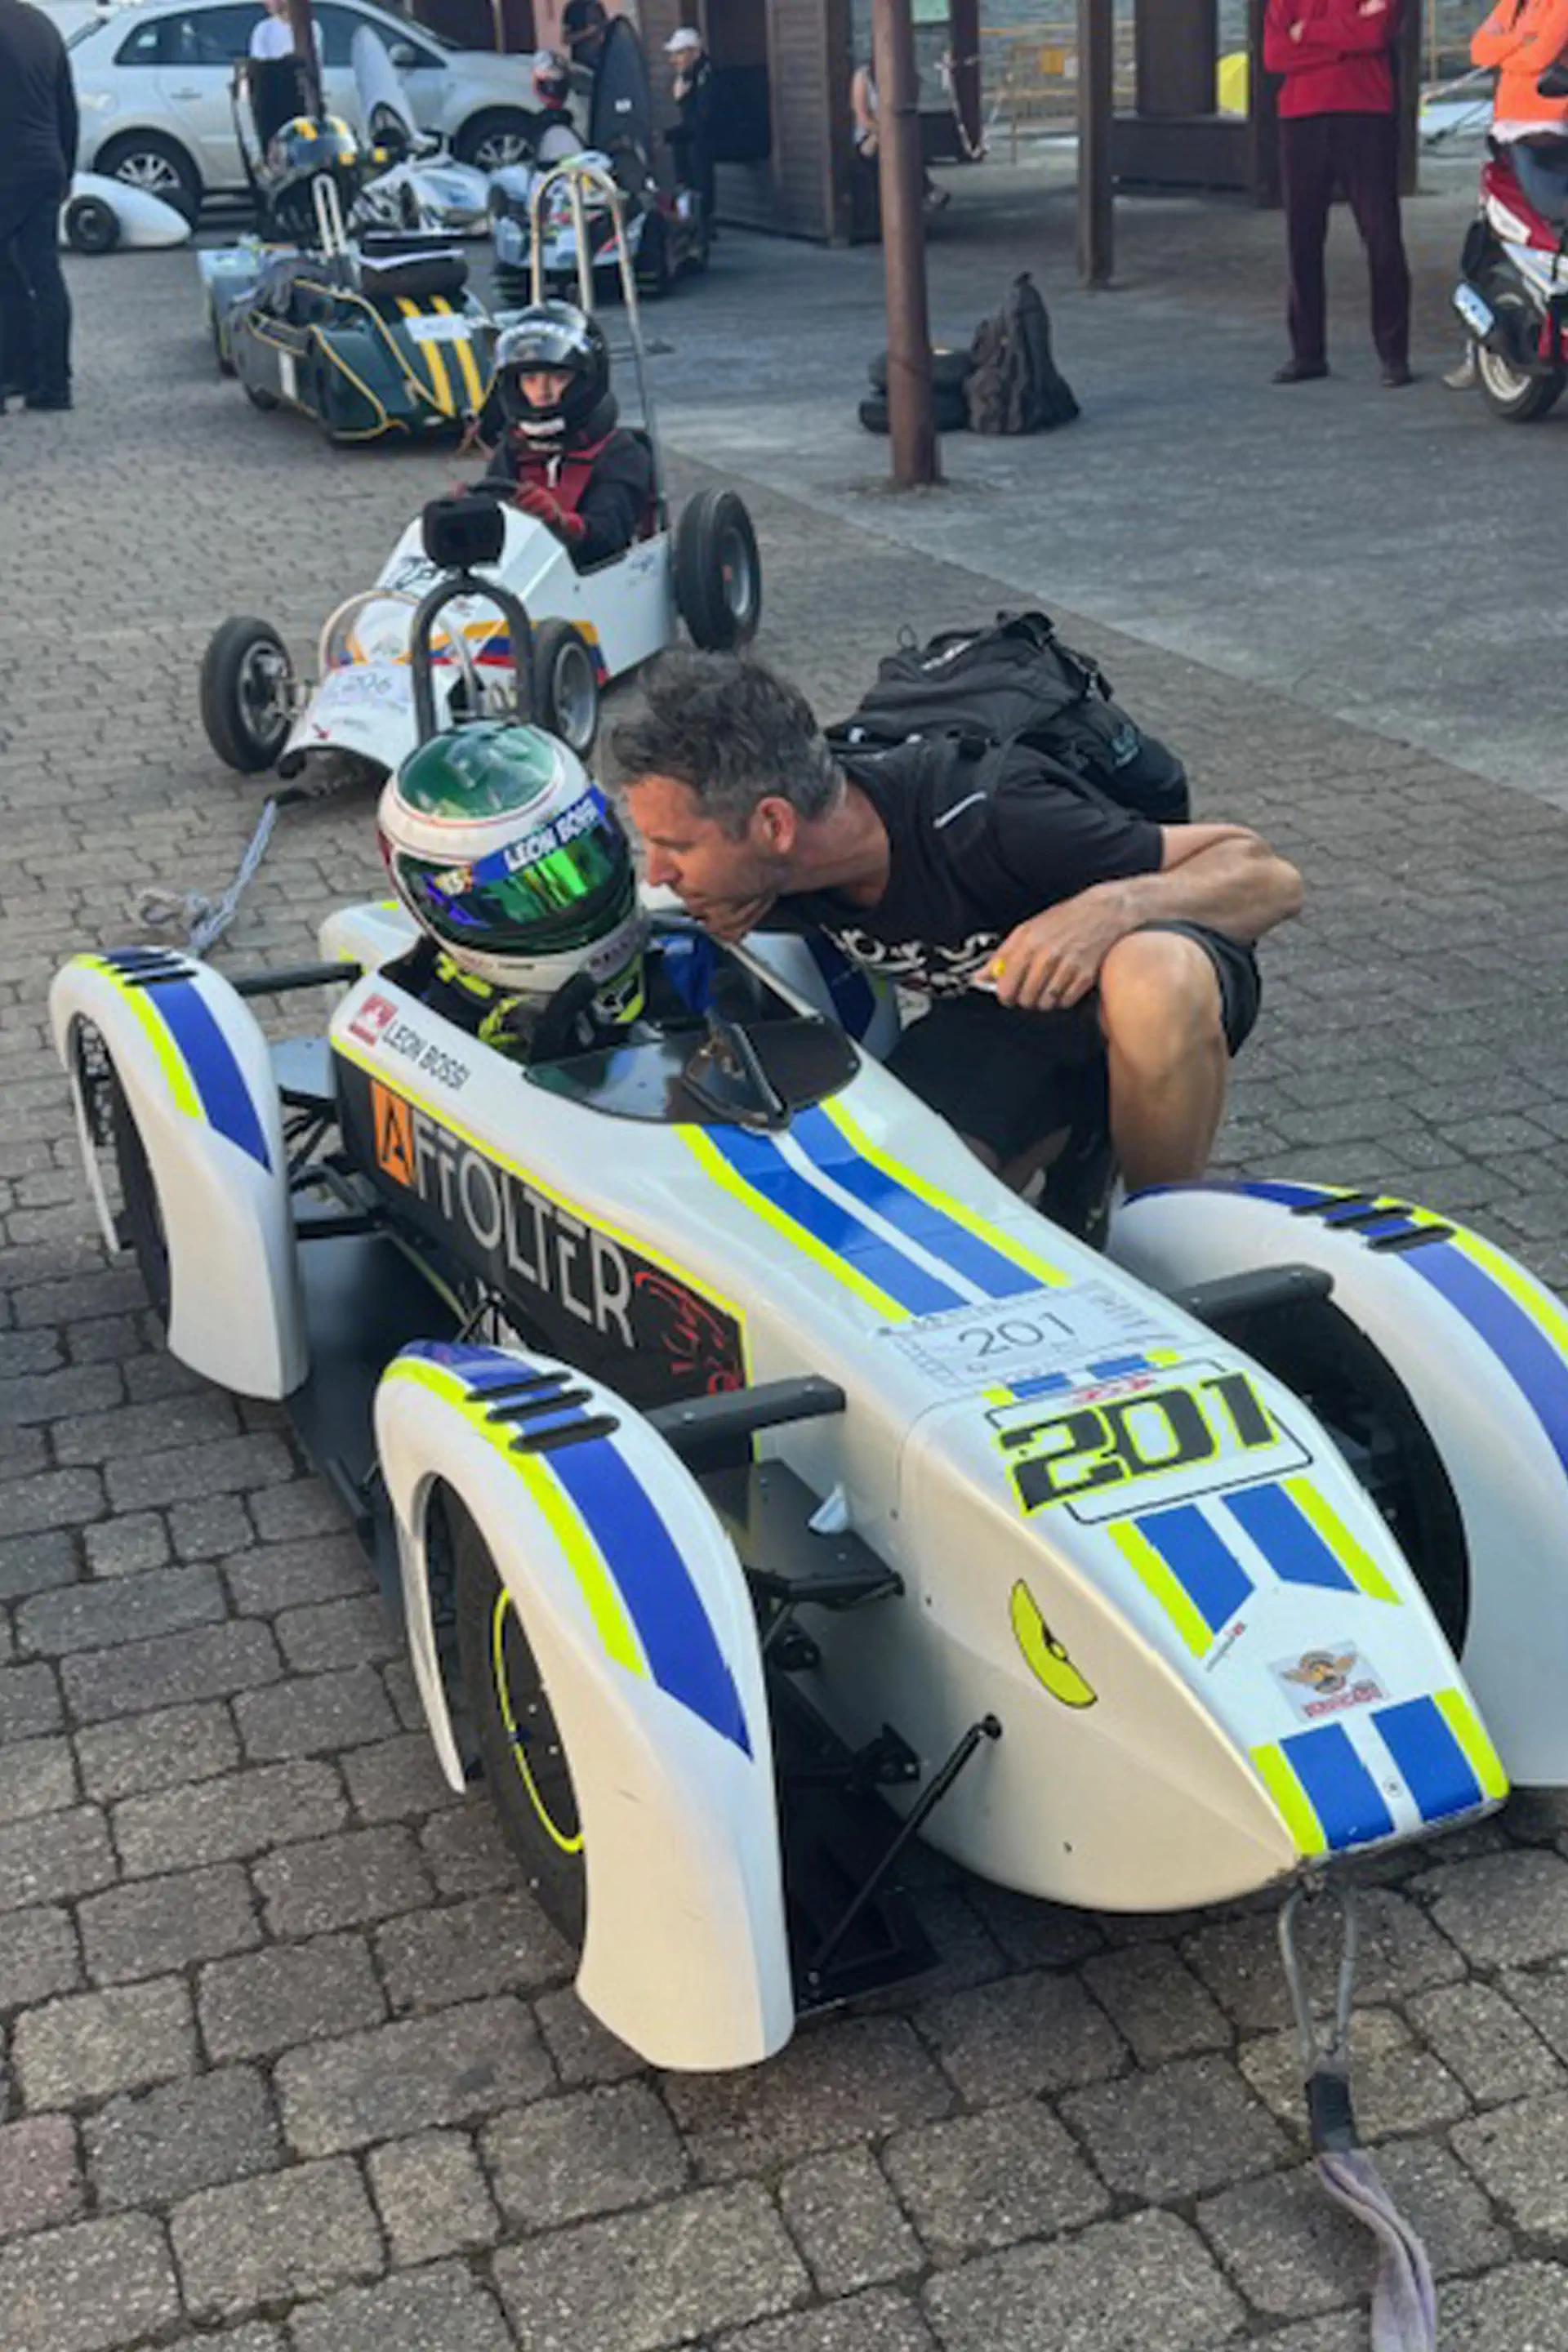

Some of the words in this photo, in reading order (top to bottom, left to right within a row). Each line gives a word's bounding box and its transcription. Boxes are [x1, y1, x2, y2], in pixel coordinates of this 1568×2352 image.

[503, 826, 561, 872] LEON
[382, 1020, 429, 1062] LEON
[417, 1045, 471, 1091] BOSSI
[373, 1080, 636, 1349] AFFOLTER
[958, 1310, 1076, 1357] 201
[998, 1370, 1276, 1512] 201
